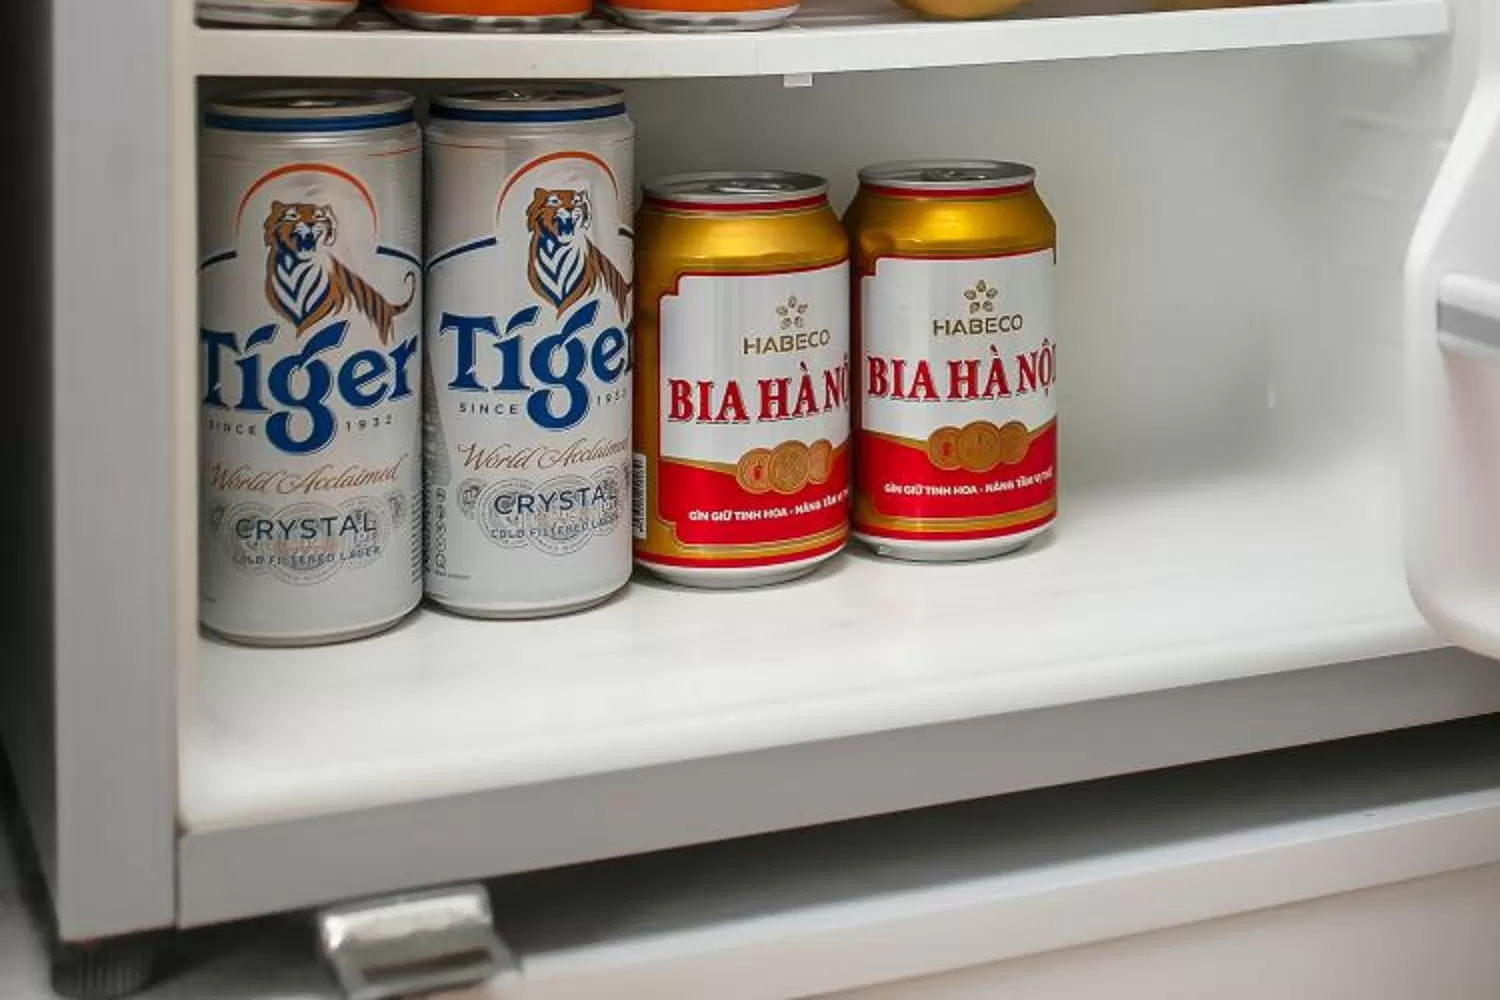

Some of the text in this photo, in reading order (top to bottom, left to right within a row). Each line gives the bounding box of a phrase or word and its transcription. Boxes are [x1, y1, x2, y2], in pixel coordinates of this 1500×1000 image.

[932, 314, 1024, 337] HABECO
[743, 329, 831, 355] HABECO
[199, 318, 419, 455] Tiger
[867, 355, 941, 402] BIA
[458, 403, 519, 415] SINCE
[668, 376, 751, 424] BIA
[457, 442, 541, 472] World
[235, 509, 377, 541] CRYSTAL
